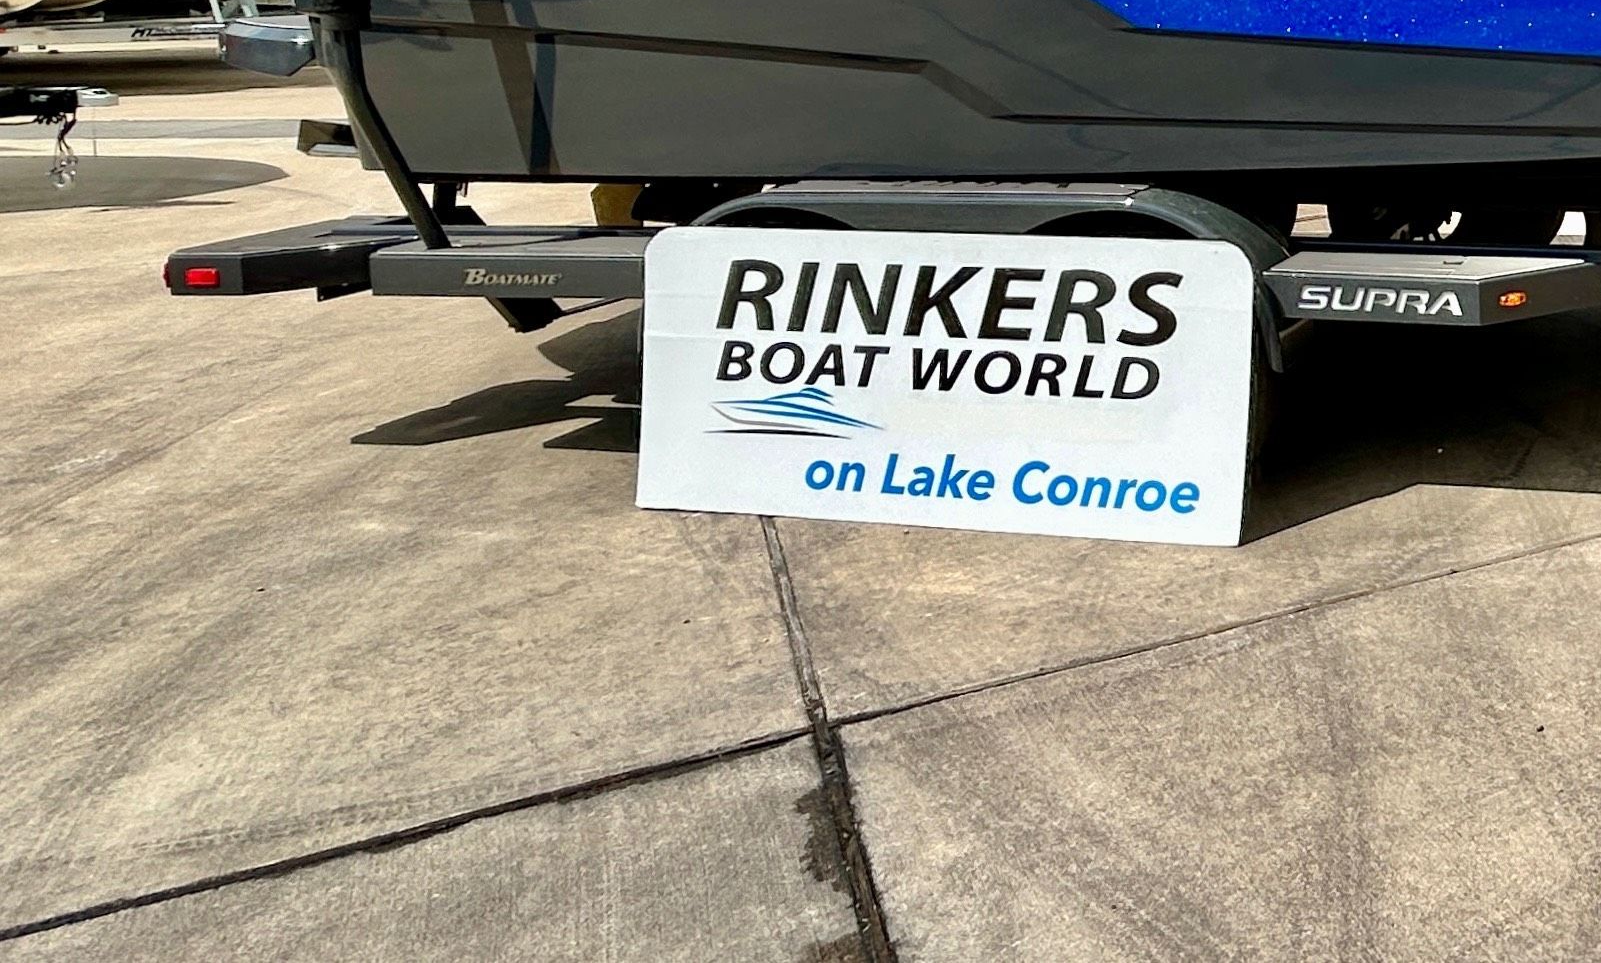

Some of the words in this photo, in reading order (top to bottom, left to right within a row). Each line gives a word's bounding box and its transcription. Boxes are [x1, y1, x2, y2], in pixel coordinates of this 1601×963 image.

[715, 259, 1184, 346] RINKERS
[1298, 286, 1464, 317] SUPRA
[715, 340, 889, 388] BOAT
[911, 347, 1161, 400] WORLD
[804, 458, 866, 494] on
[879, 453, 996, 502] Lake
[1012, 460, 1201, 514] Conroe
